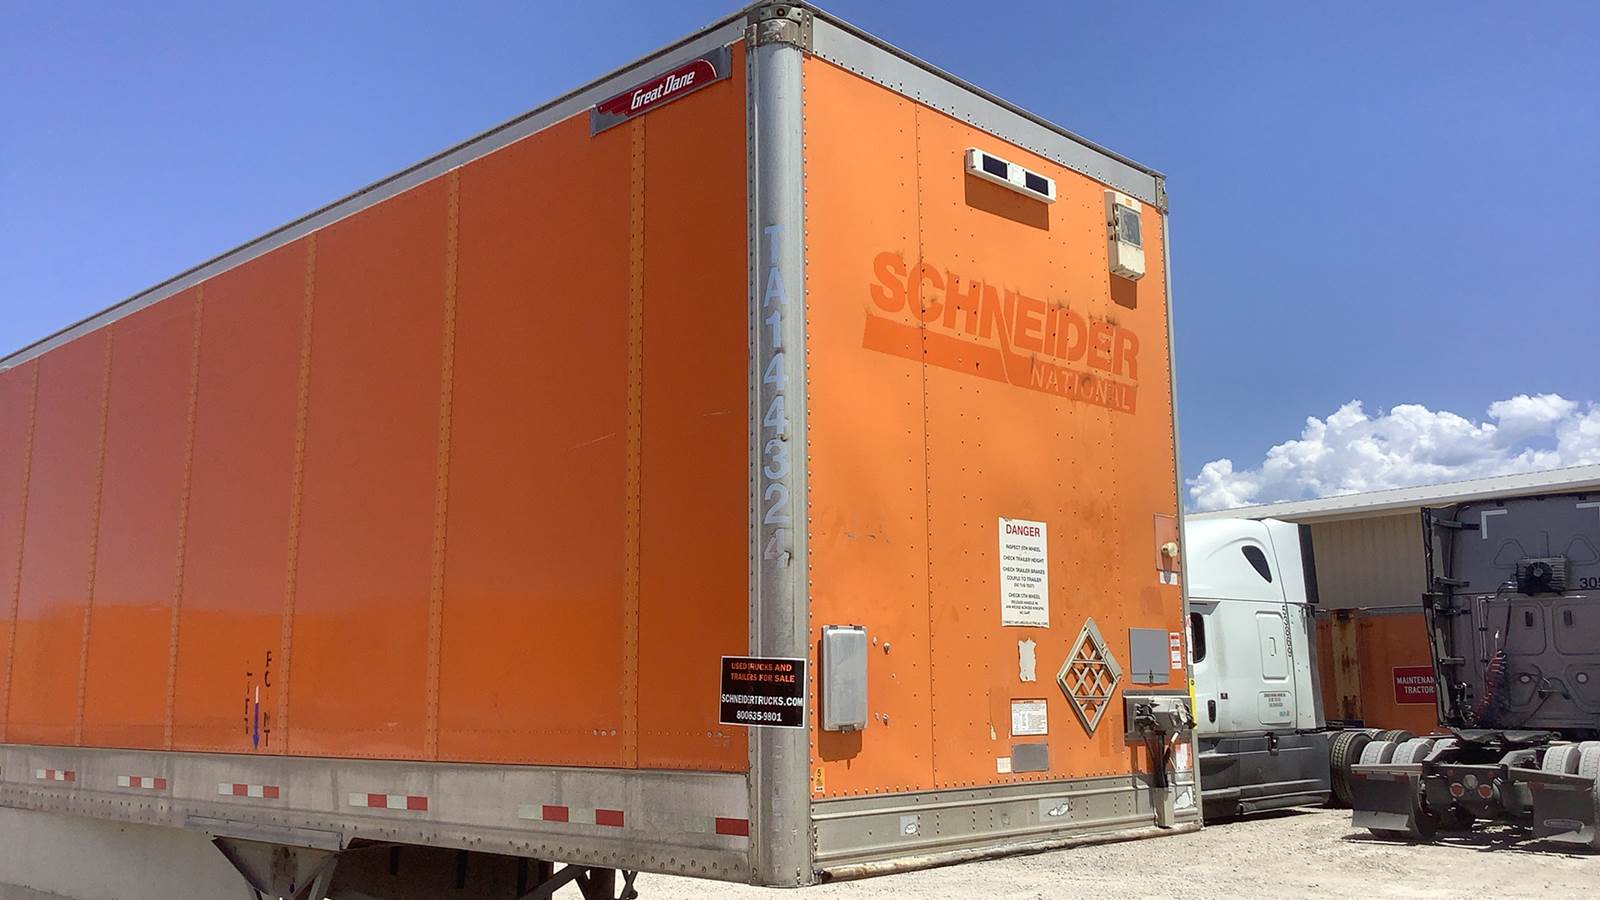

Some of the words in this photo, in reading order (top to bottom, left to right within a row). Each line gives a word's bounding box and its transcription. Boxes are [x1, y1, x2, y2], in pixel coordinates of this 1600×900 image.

[631, 83, 664, 110] Great
[663, 71, 695, 96] Dane
[869, 250, 1140, 381] SCHNEIDER
[1031, 363, 1131, 411] NATIONAL
[763, 224, 789, 568] TA144324
[1005, 523, 1041, 537] DANGER
[1580, 577, 1600, 589] 30
[731, 662, 747, 670] USED
[774, 664, 792, 672] AND
[730, 673, 757, 681] TRAILERS
[774, 674, 796, 683] SALE
[721, 694, 803, 706] SCHNEIDERTRUCKS.COM
